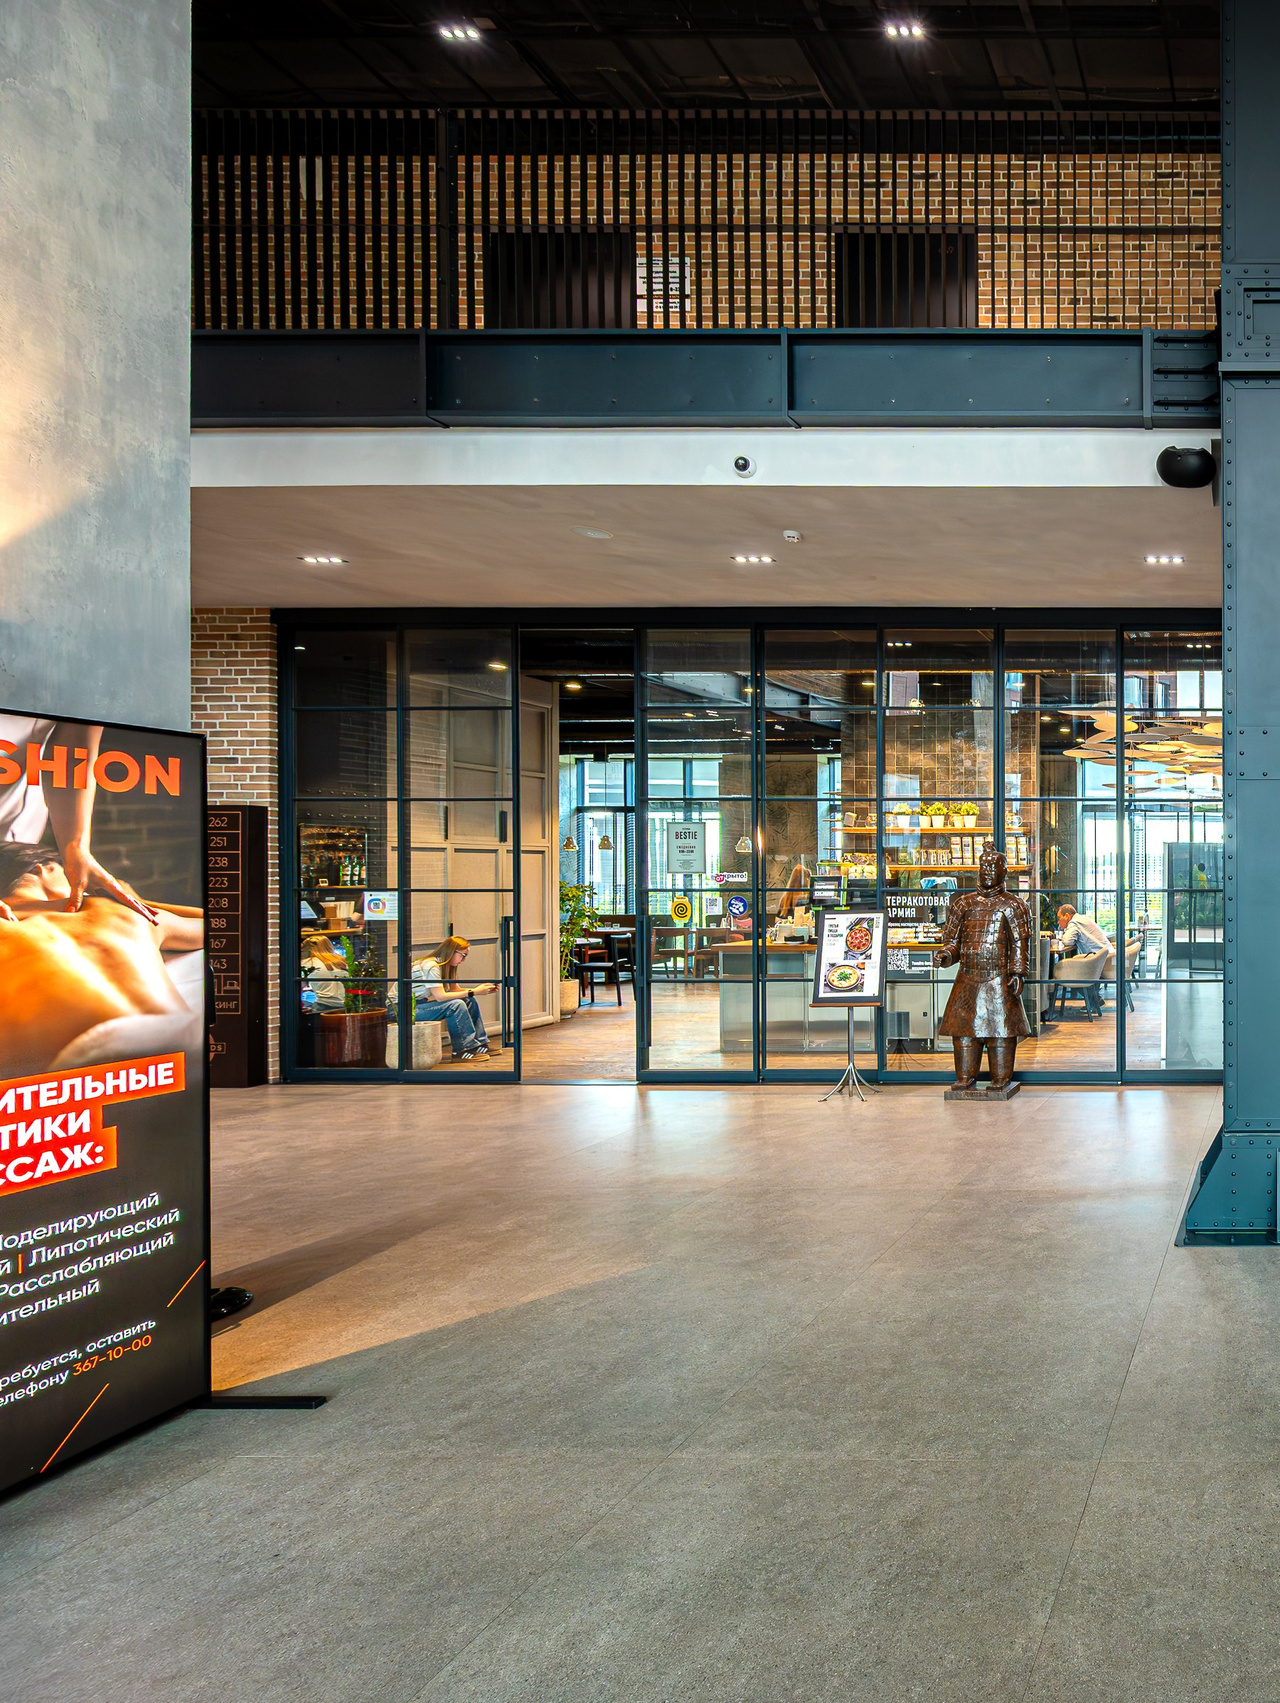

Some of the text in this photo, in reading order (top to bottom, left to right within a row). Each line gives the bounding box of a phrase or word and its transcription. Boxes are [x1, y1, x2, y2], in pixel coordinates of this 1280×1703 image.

[208, 817, 228, 827] 262
[675, 831, 698, 840] BESTIE
[210, 837, 227, 847] 251
[208, 857, 229, 867] 238
[208, 877, 229, 887] 223
[208, 898, 229, 908] 208
[886, 896, 950, 906] ТЕРРАКОТОВАЯ
[887, 907, 916, 918] АРМИЯ
[210, 918, 227, 928] 188
[209, 939, 227, 949] 167
[209, 959, 227, 969] 143
[0, 1109, 91, 1151] ТИКИ
[0, 1142, 104, 1186] САЖ:
[0, 1192, 160, 1250] оделирующий
[28, 1208, 181, 1267] Липотический
[85, 1320, 156, 1353] оставить
[72, 1335, 152, 1376] 367-10-00
